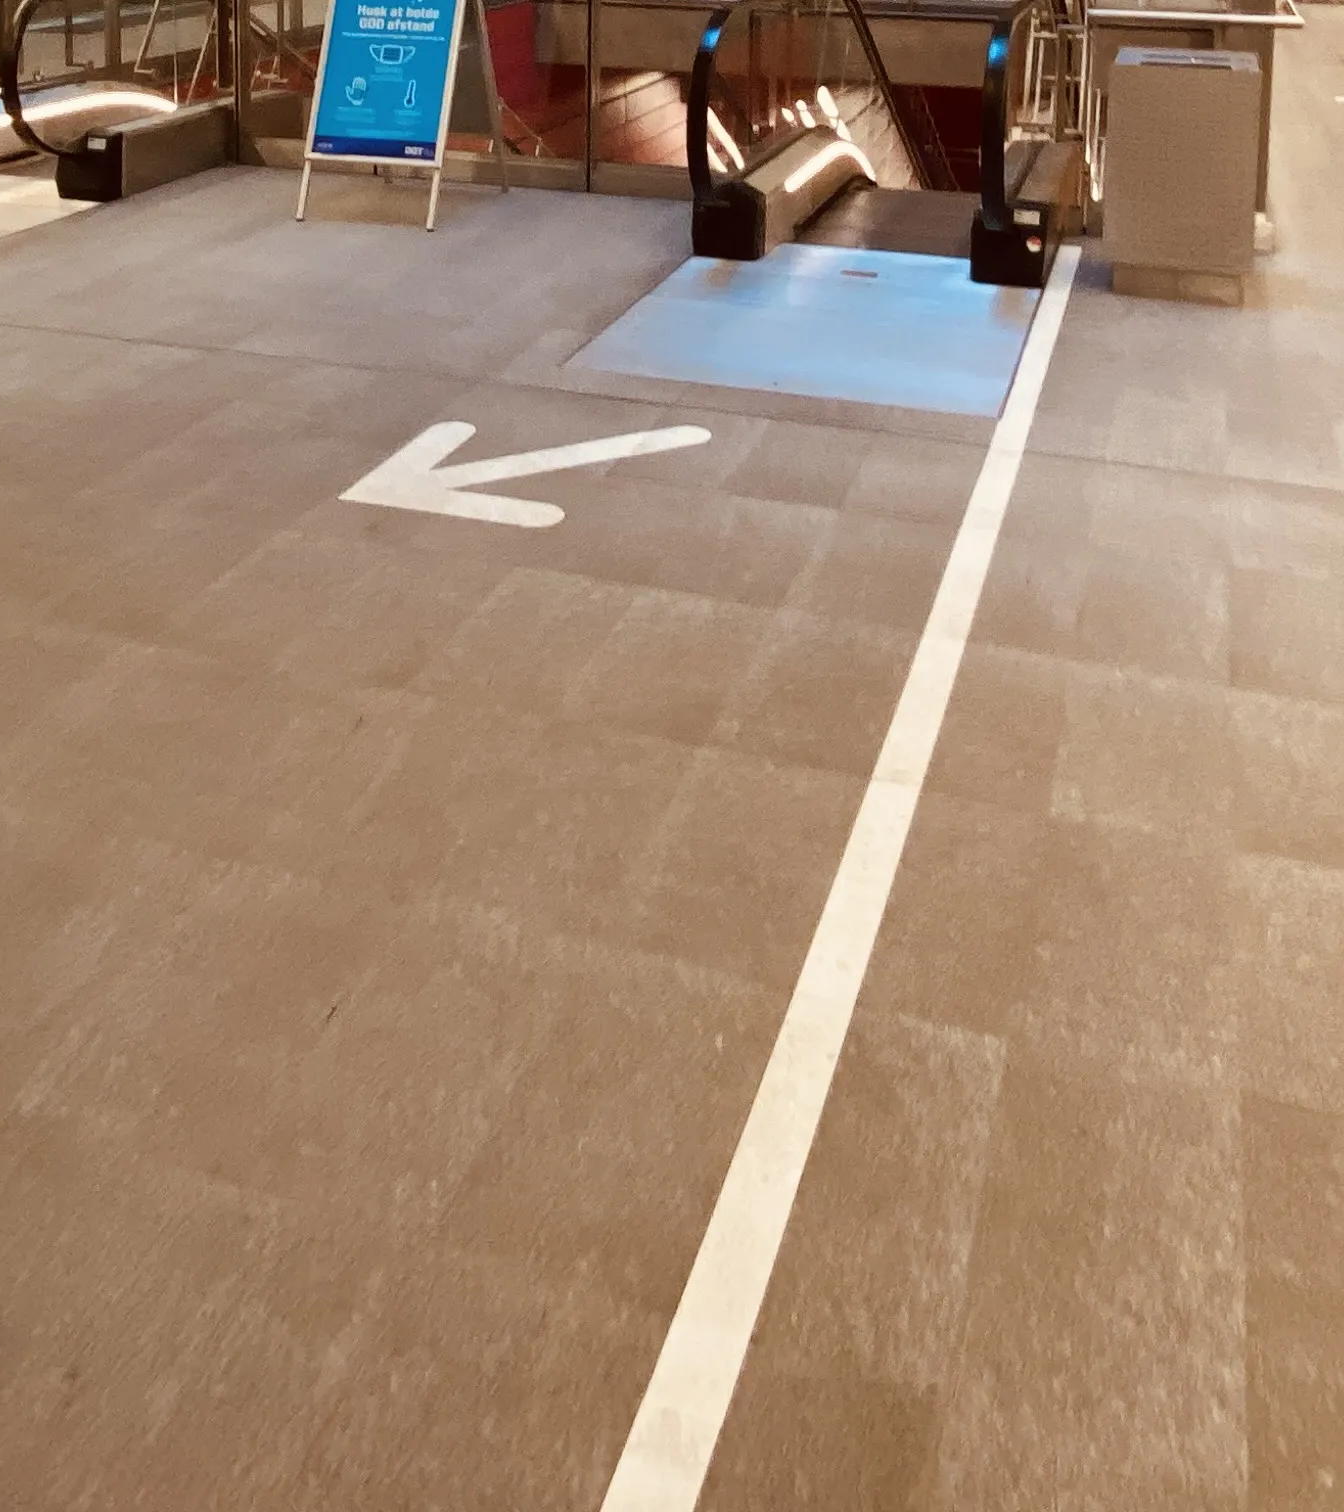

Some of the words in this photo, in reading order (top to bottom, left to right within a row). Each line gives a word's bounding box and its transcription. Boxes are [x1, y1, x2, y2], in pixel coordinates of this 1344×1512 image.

[357, 4, 387, 17] Husk
[389, 6, 404, 18] at
[406, 6, 440, 19] holde
[359, 16, 385, 30] GOD
[387, 19, 435, 32] afstand
